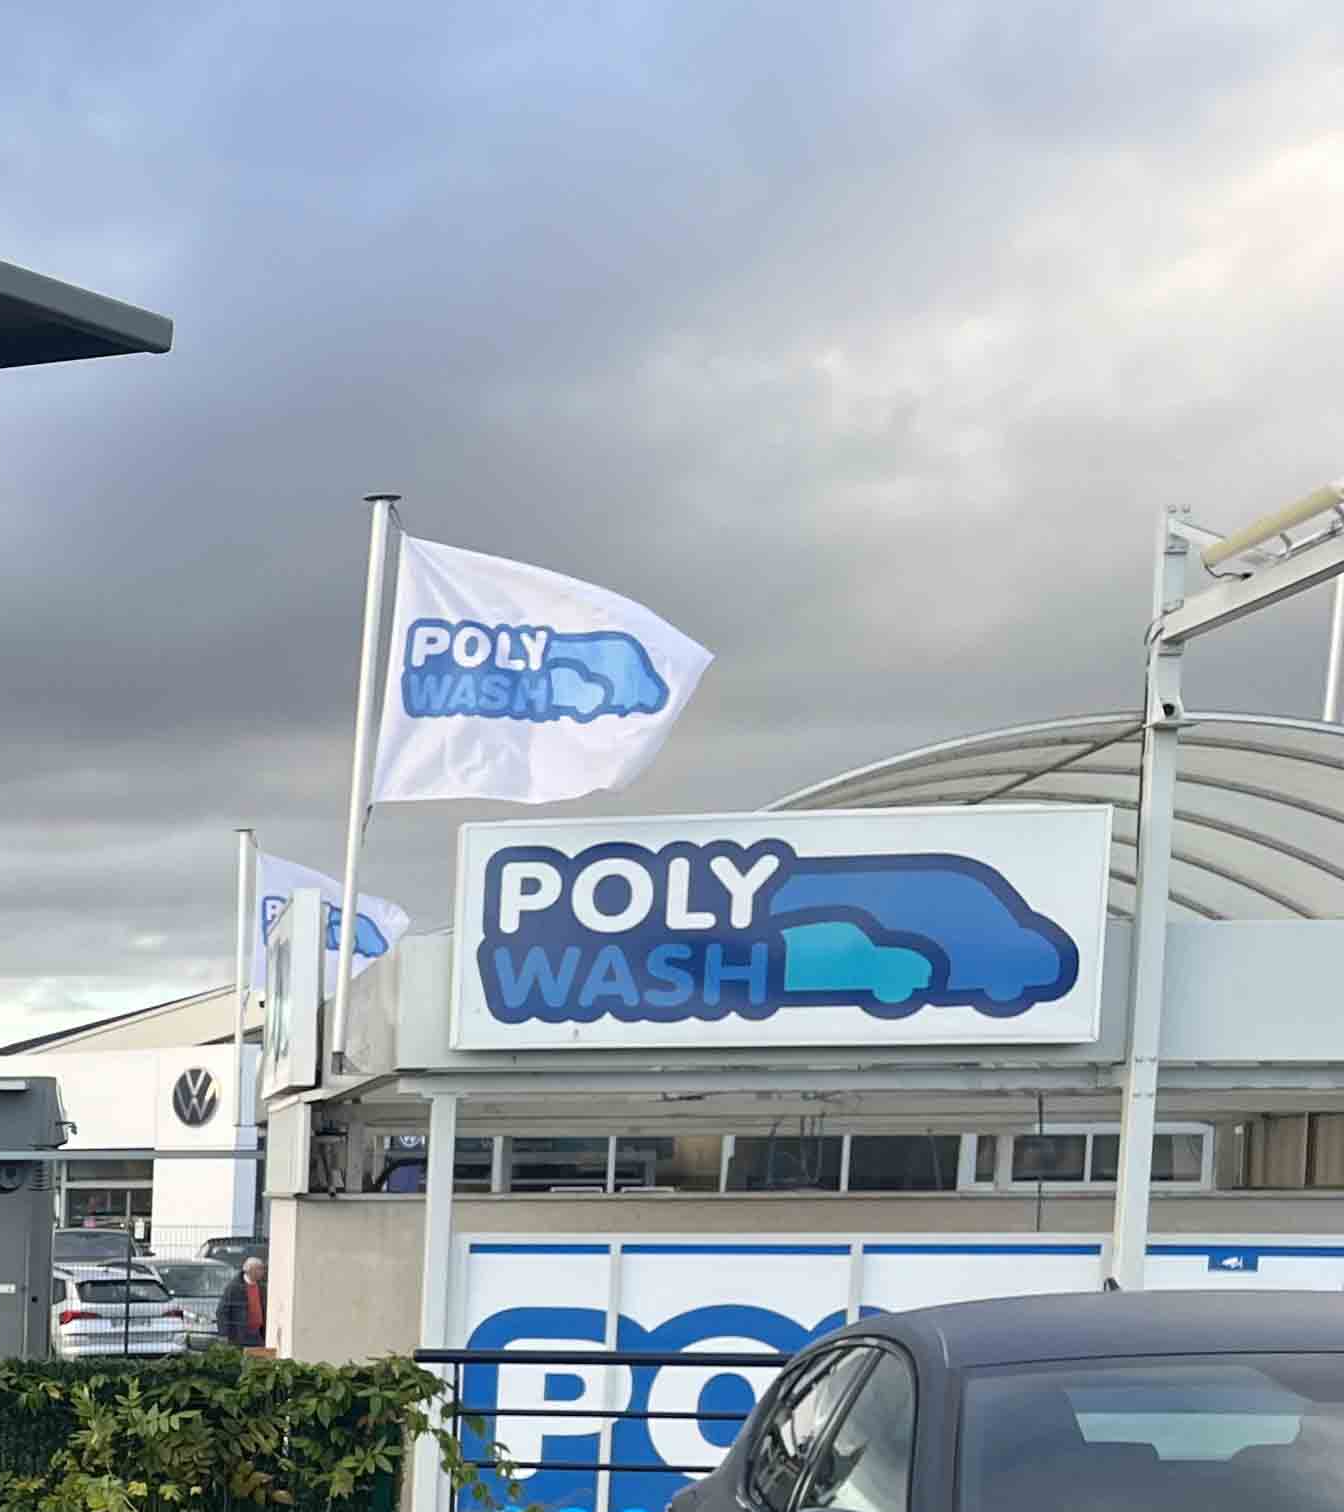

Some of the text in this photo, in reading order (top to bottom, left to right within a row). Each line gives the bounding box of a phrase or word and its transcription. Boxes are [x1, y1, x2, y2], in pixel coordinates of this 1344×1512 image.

[411, 625, 549, 672] POLY
[411, 671, 549, 714] WASH
[499, 853, 780, 934] POLY
[494, 942, 769, 1007] WASH
